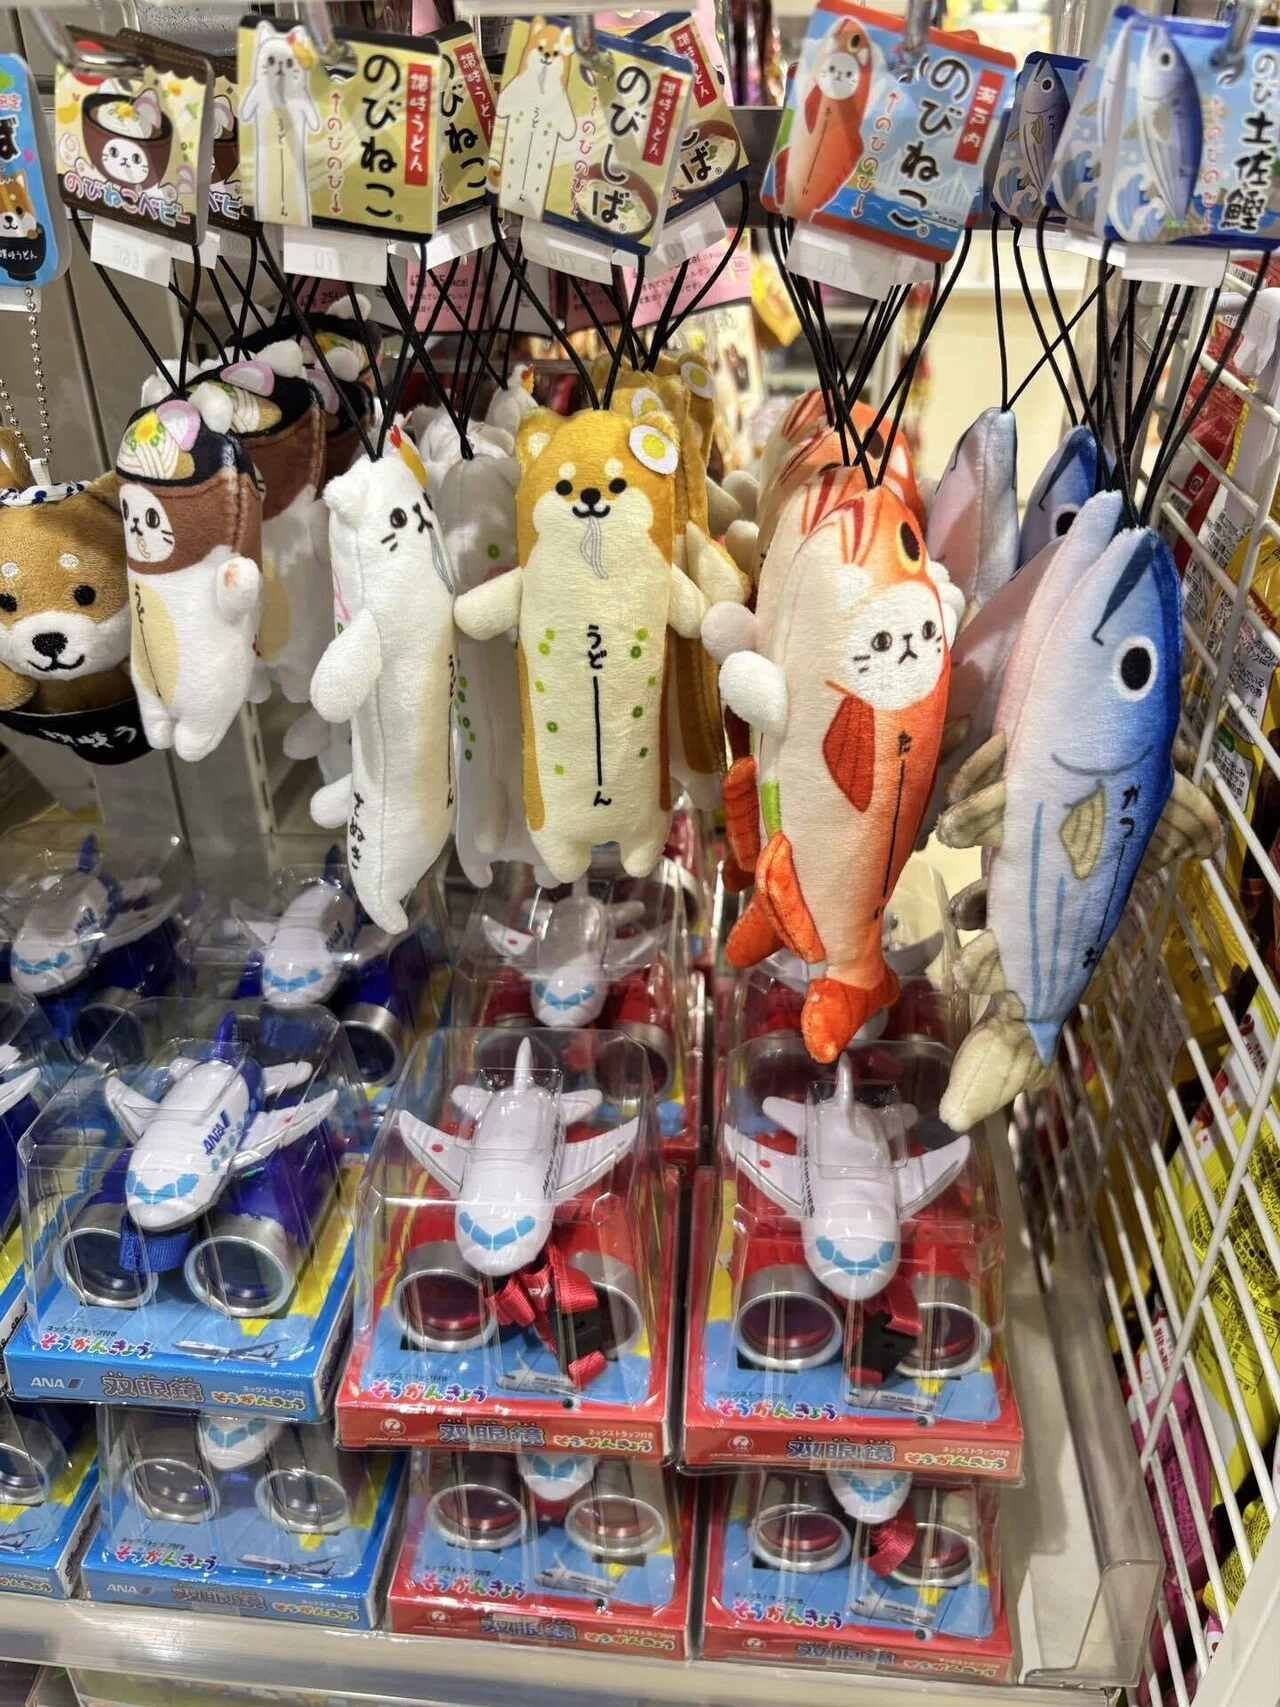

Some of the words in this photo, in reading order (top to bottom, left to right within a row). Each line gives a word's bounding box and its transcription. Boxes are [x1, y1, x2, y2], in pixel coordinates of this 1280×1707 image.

[410, 73, 428, 171] 讃岐うどん
[650, 80, 675, 156] 讃岐うどん
[963, 84, 998, 148] 瀬戸内
[361, 55, 401, 218] のびねこ
[890, 57, 971, 228] のびねこ
[64, 172, 190, 227] のびねこベビー
[38, 1333, 152, 1358] そうがんきょう
[30, 1377, 65, 1389] ANA
[100, 1371, 205, 1402] 双眼鏡
[370, 1382, 489, 1403] そうがんきょう
[716, 1400, 838, 1421] そうがんきょう
[106, 1584, 138, 1594] ANA
[421, 1573, 528, 1600] そうがんきょう
[733, 1600, 844, 1630] そうがんきょう
